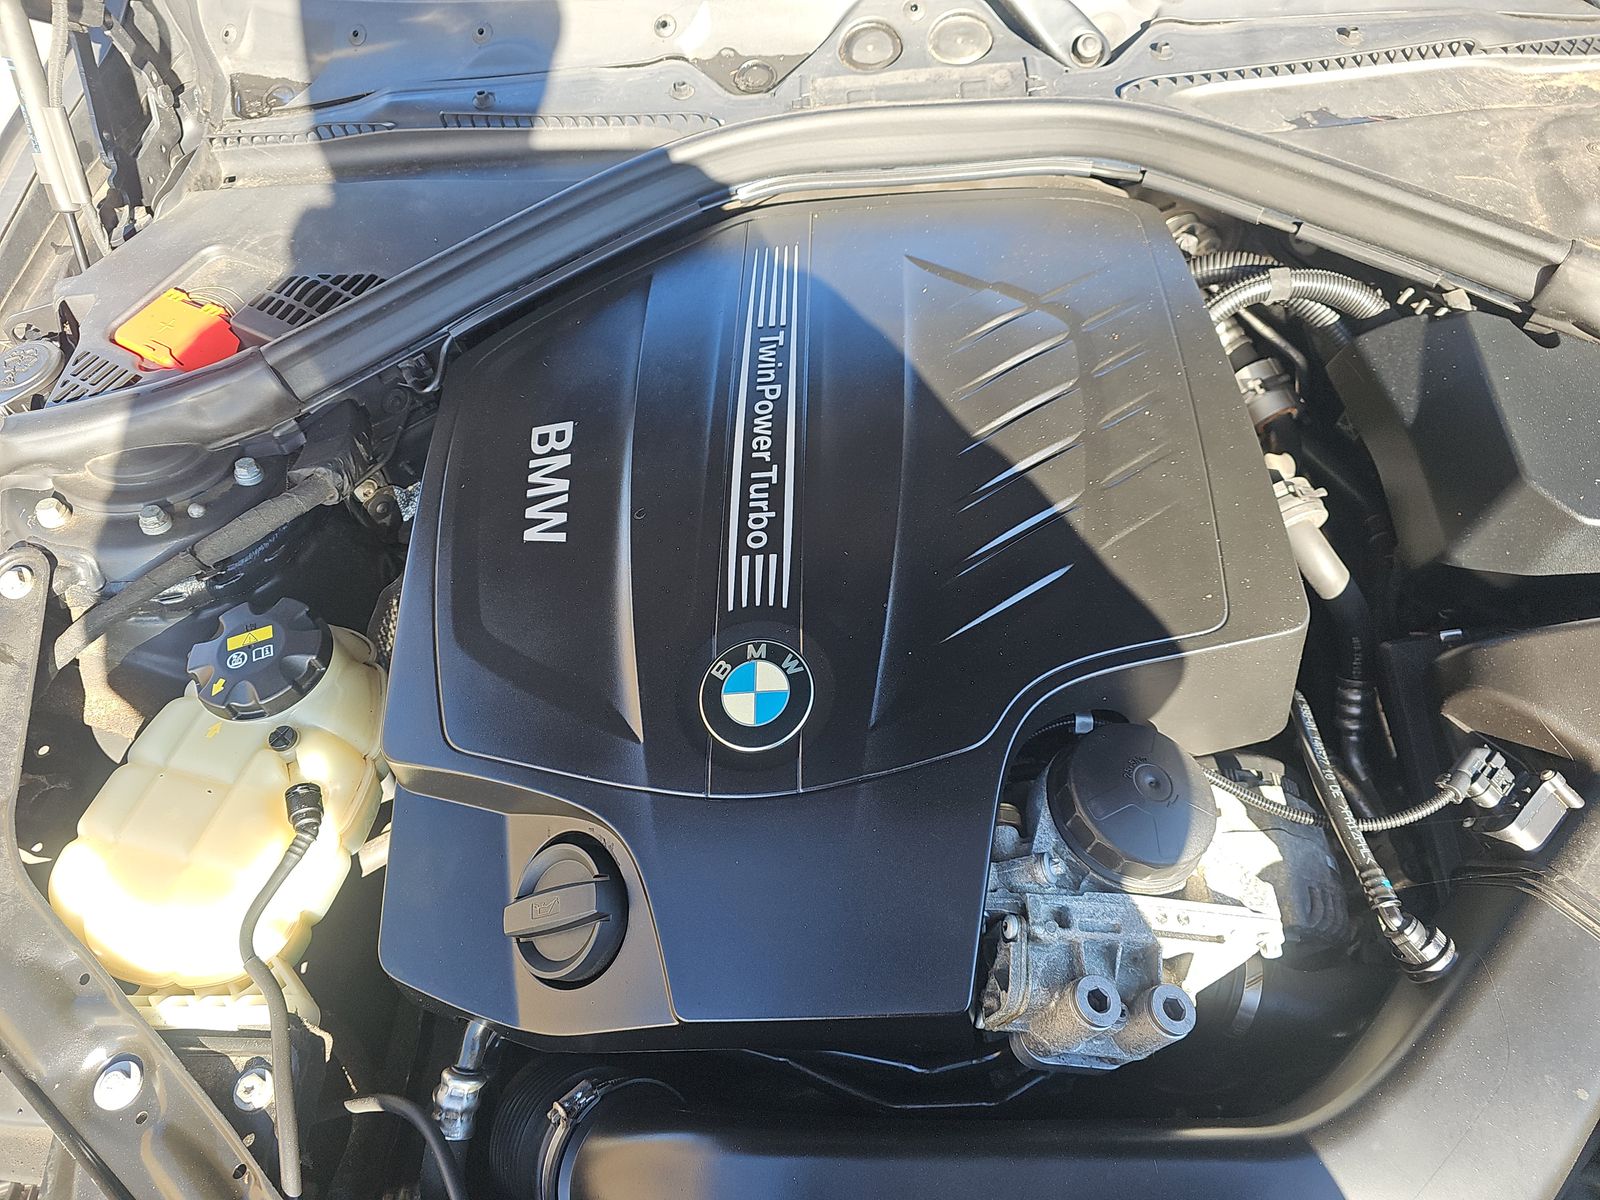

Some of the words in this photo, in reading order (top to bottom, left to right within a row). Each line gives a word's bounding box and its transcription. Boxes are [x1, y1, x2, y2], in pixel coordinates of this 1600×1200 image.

[751, 331, 784, 462] TwinPower
[523, 421, 574, 543] BMW
[746, 464, 778, 549] Turbo
[711, 644, 804, 681] BMW
[1329, 784, 1344, 799] DE
